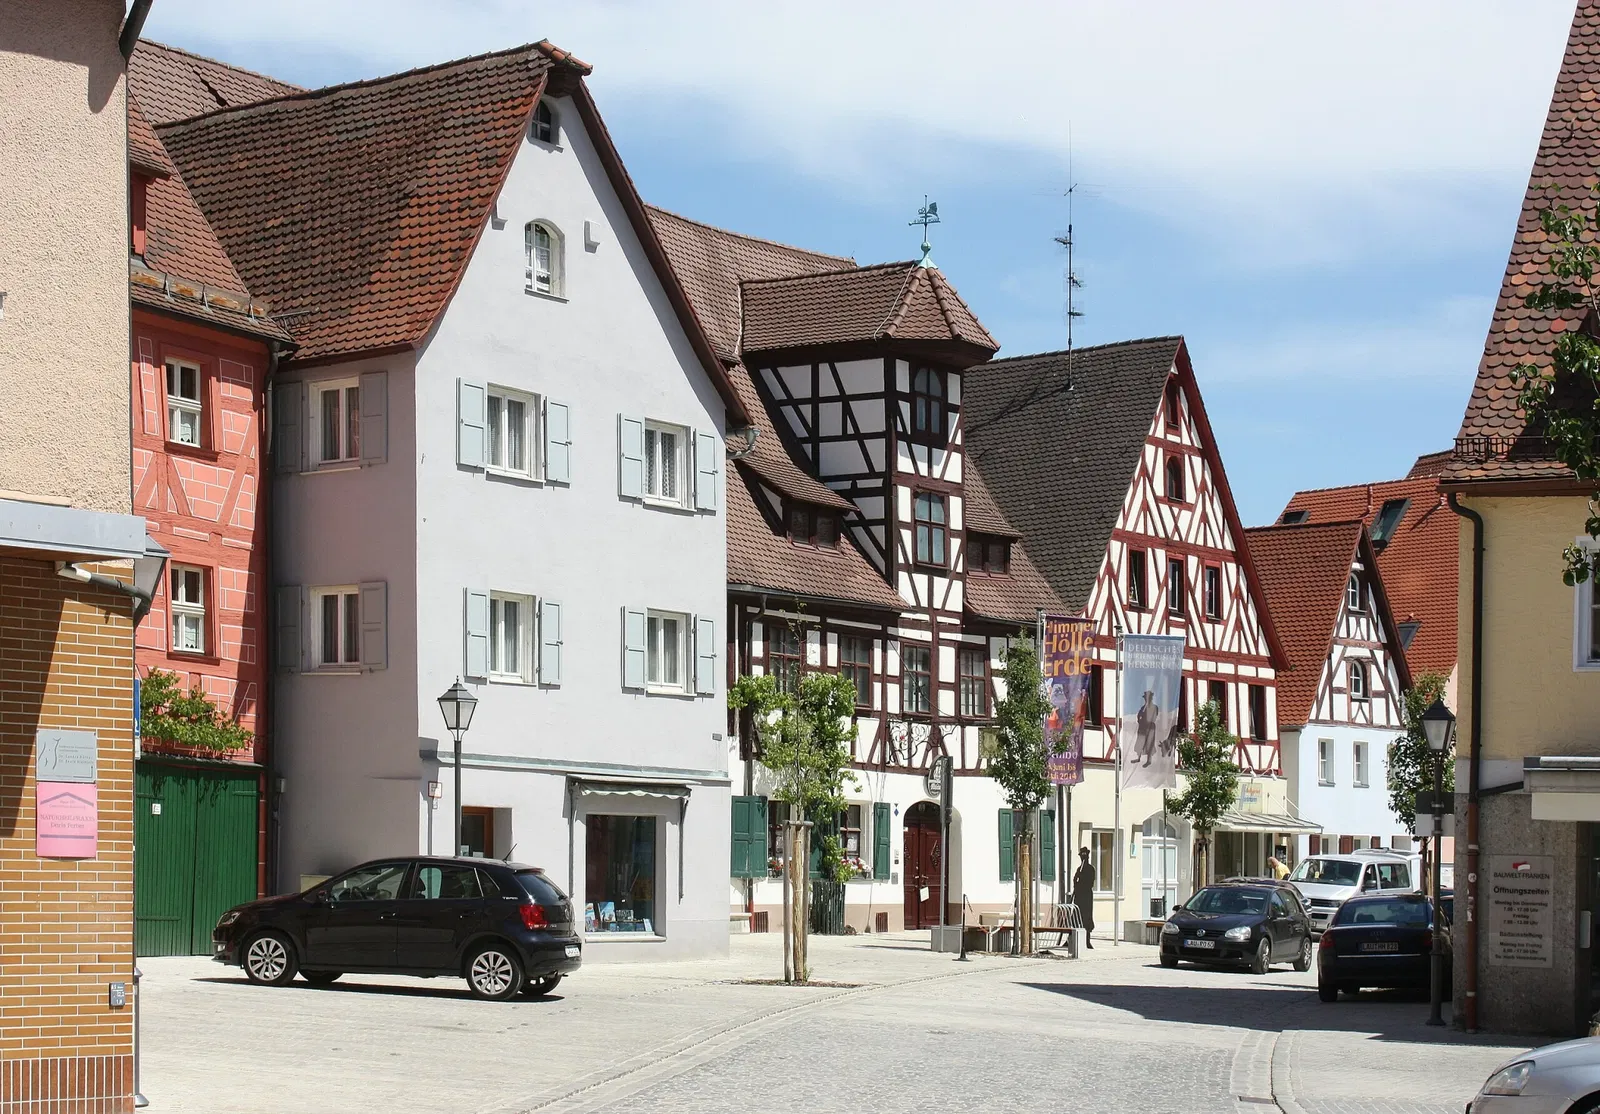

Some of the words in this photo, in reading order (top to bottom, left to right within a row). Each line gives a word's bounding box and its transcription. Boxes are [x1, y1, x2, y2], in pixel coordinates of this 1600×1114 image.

[1045, 632, 1093, 653] Hölle
[1128, 644, 1181, 654] DEUTSCHES
[1044, 651, 1092, 677] Erde
[1493, 872, 1521, 880] BAUWELT
[1522, 872, 1550, 880] FRANKEN
[1493, 885, 1550, 896] Öffnungszeiten
